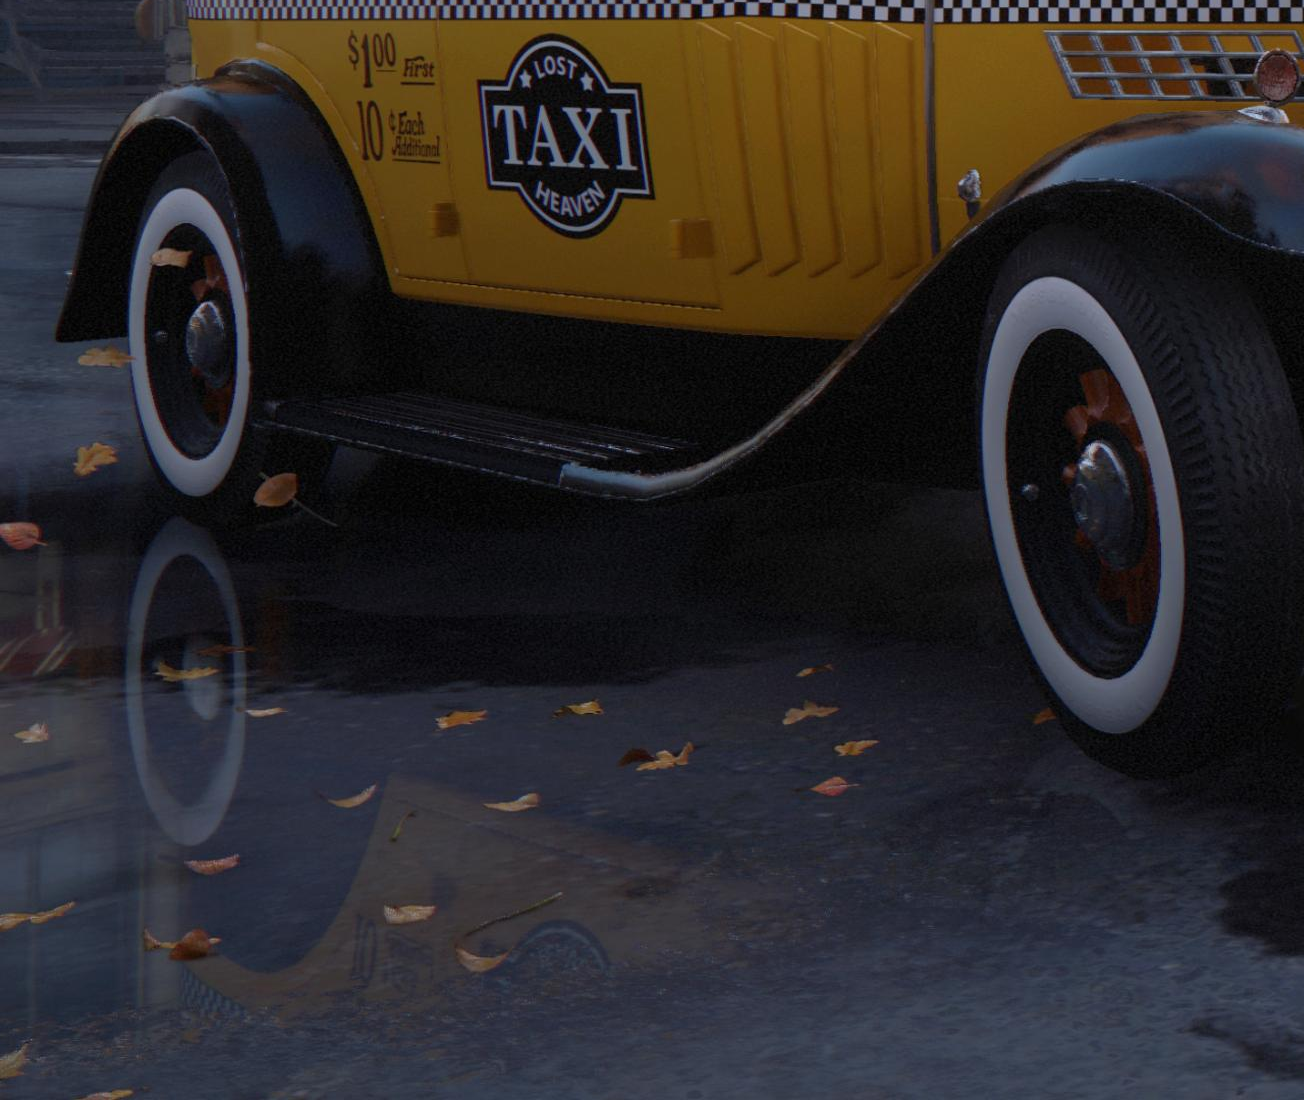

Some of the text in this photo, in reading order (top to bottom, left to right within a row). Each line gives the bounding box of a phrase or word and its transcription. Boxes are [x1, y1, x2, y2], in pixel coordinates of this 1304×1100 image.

[402, 55, 435, 78] First
[534, 55, 578, 79] LOST
[398, 110, 425, 136] Each
[392, 135, 441, 157] Additional
[492, 104, 640, 172] TAXI
[535, 180, 606, 217] HEAVEN
